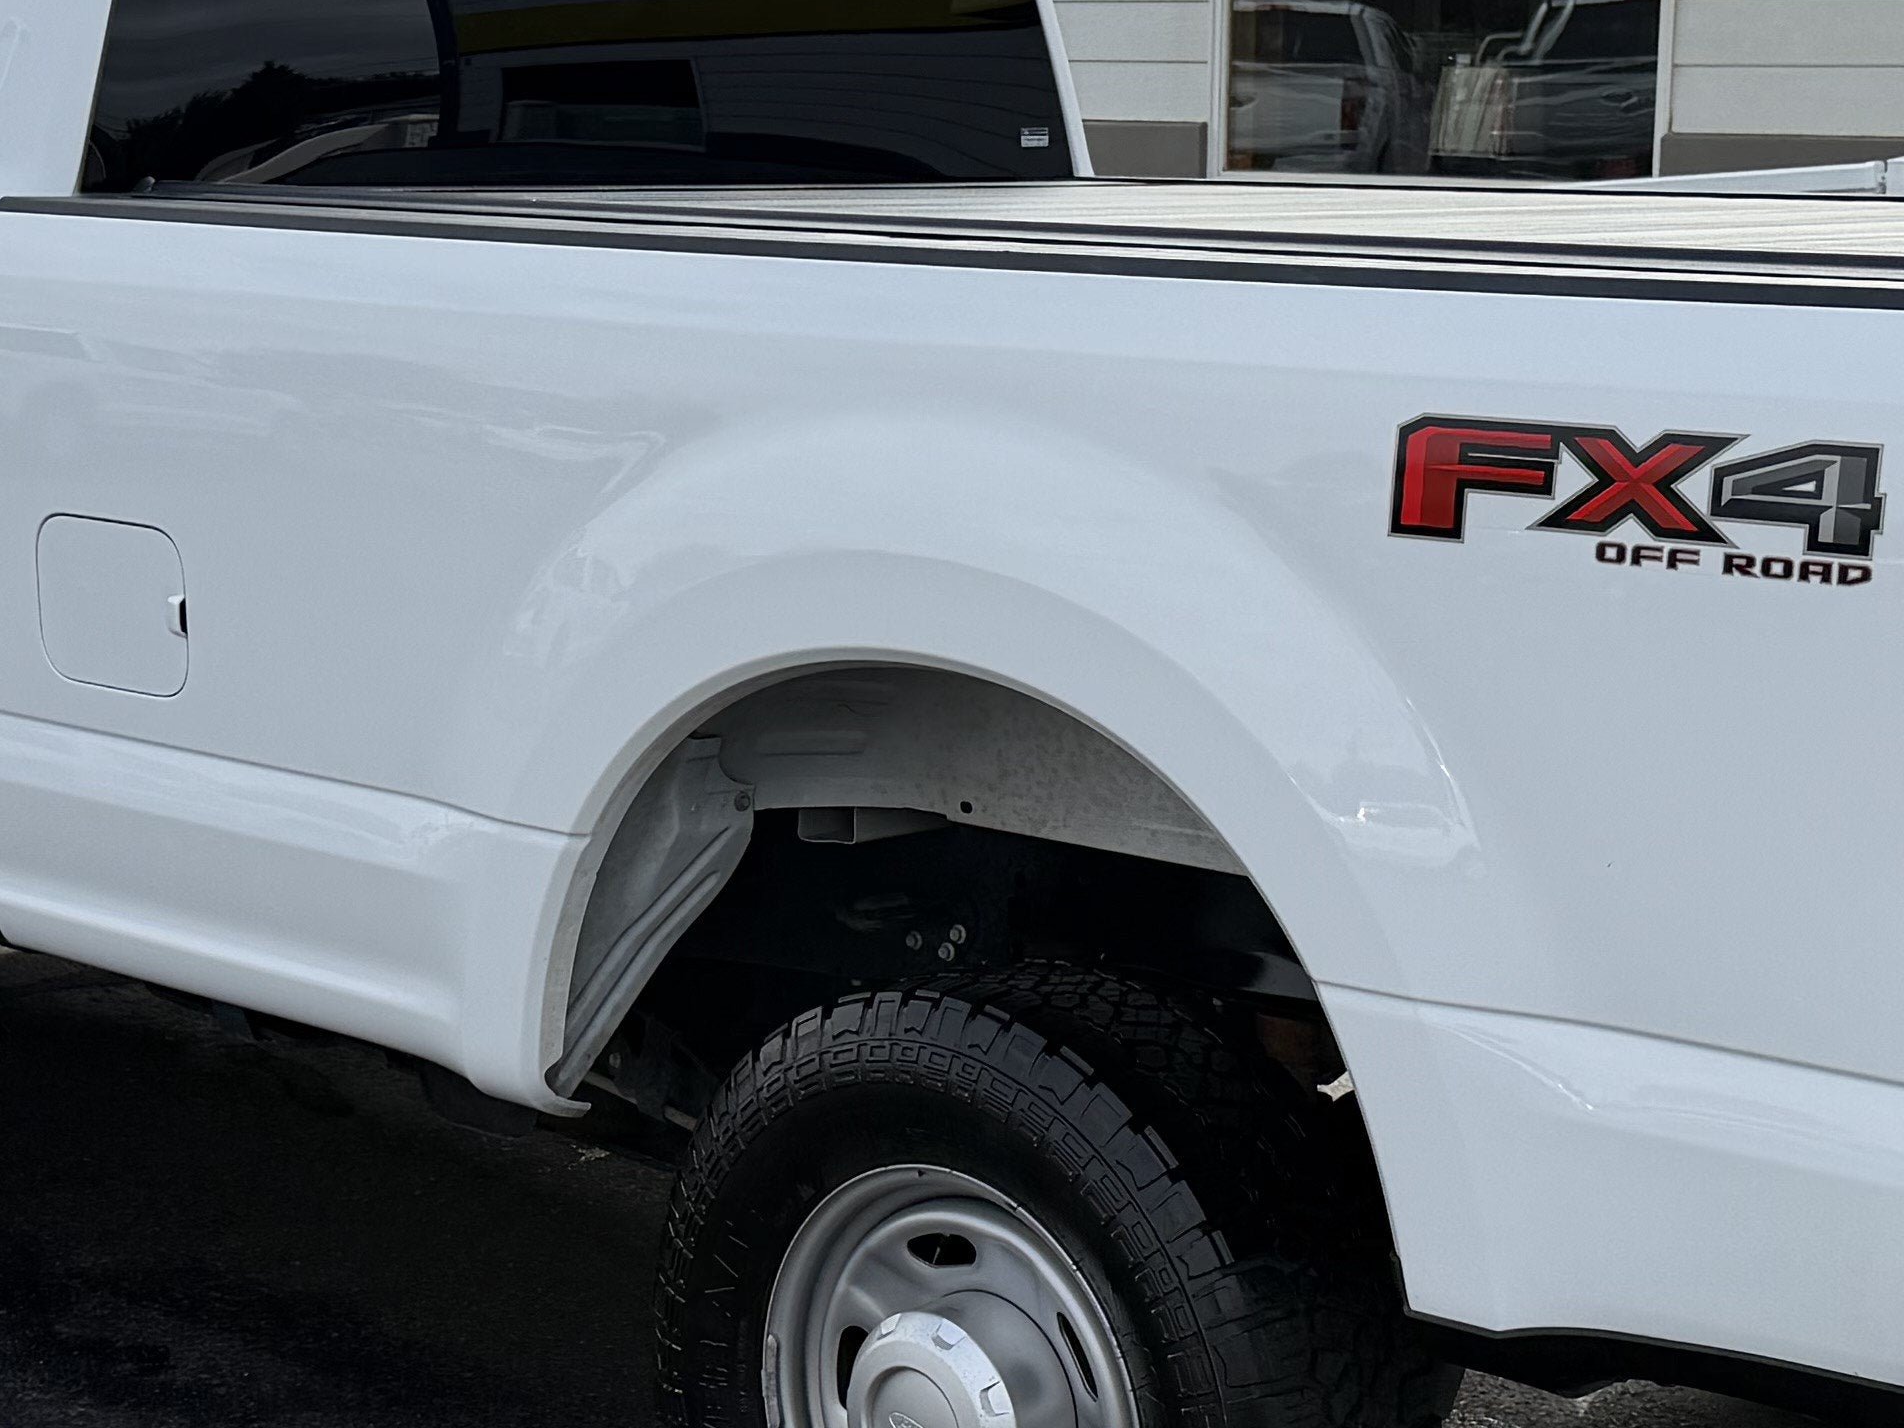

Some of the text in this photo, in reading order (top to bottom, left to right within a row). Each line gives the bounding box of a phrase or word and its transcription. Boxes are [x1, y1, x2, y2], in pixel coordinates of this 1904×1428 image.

[1387, 412, 1888, 560] FX4
[1595, 541, 1875, 588] OFF ROAD
